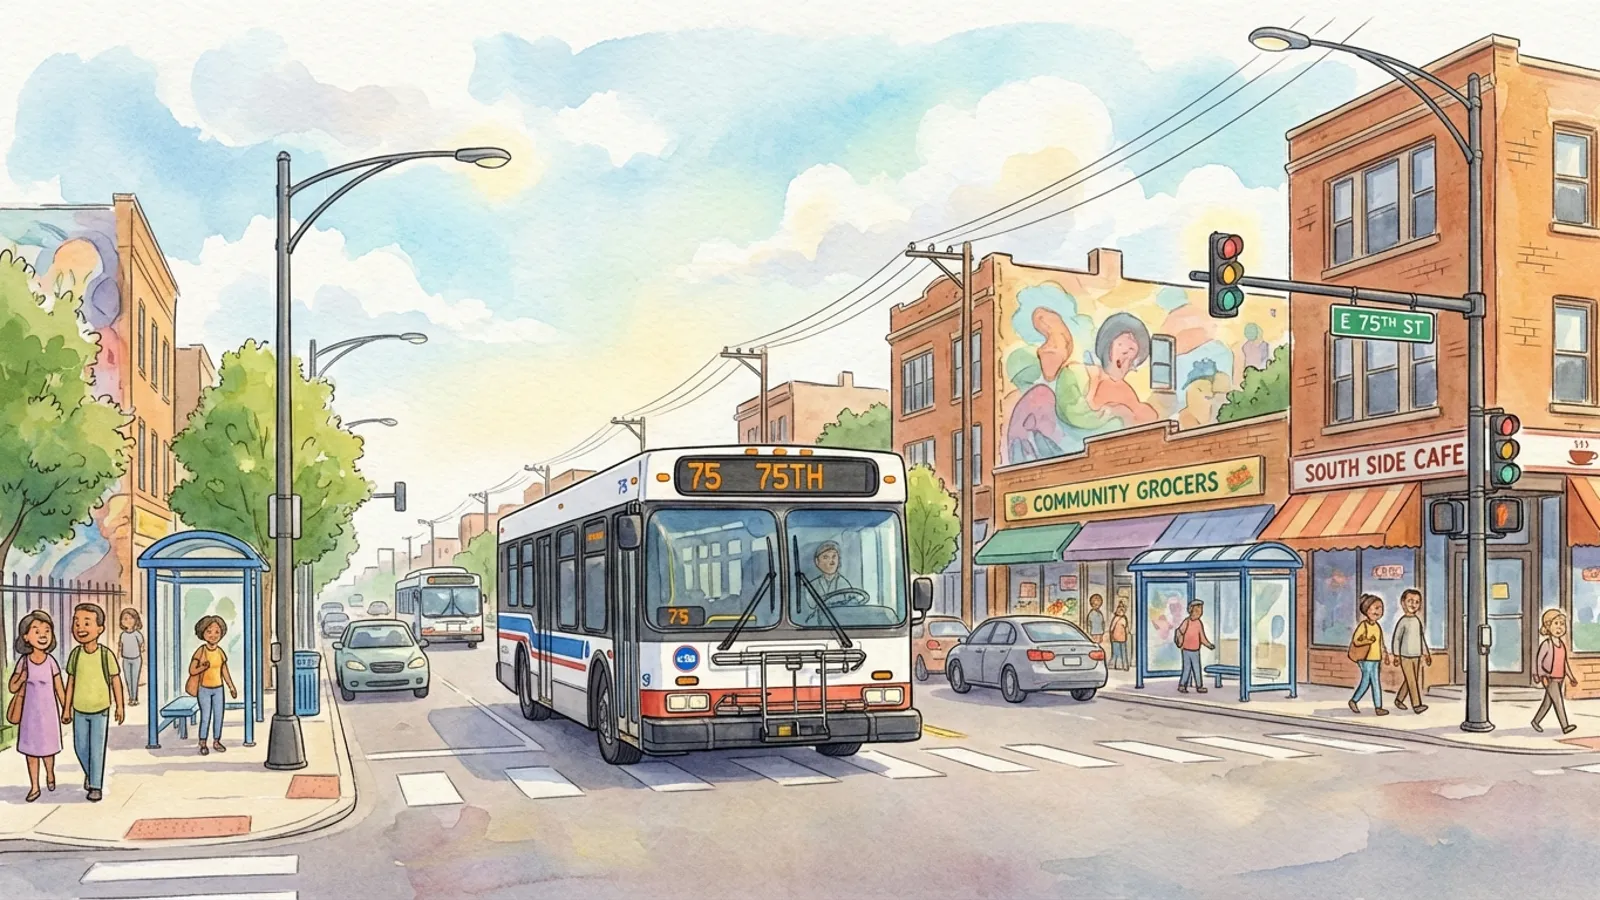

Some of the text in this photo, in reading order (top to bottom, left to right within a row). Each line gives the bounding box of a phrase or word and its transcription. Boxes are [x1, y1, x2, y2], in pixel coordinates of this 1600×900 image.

[1341, 313, 1424, 335] E 75TH ST
[688, 462, 823, 491] 75 75TH
[1305, 442, 1464, 483] SOUTH SIDE CAFE
[1033, 471, 1219, 513] COMMUNITY GROCERS
[668, 608, 689, 625] 75
